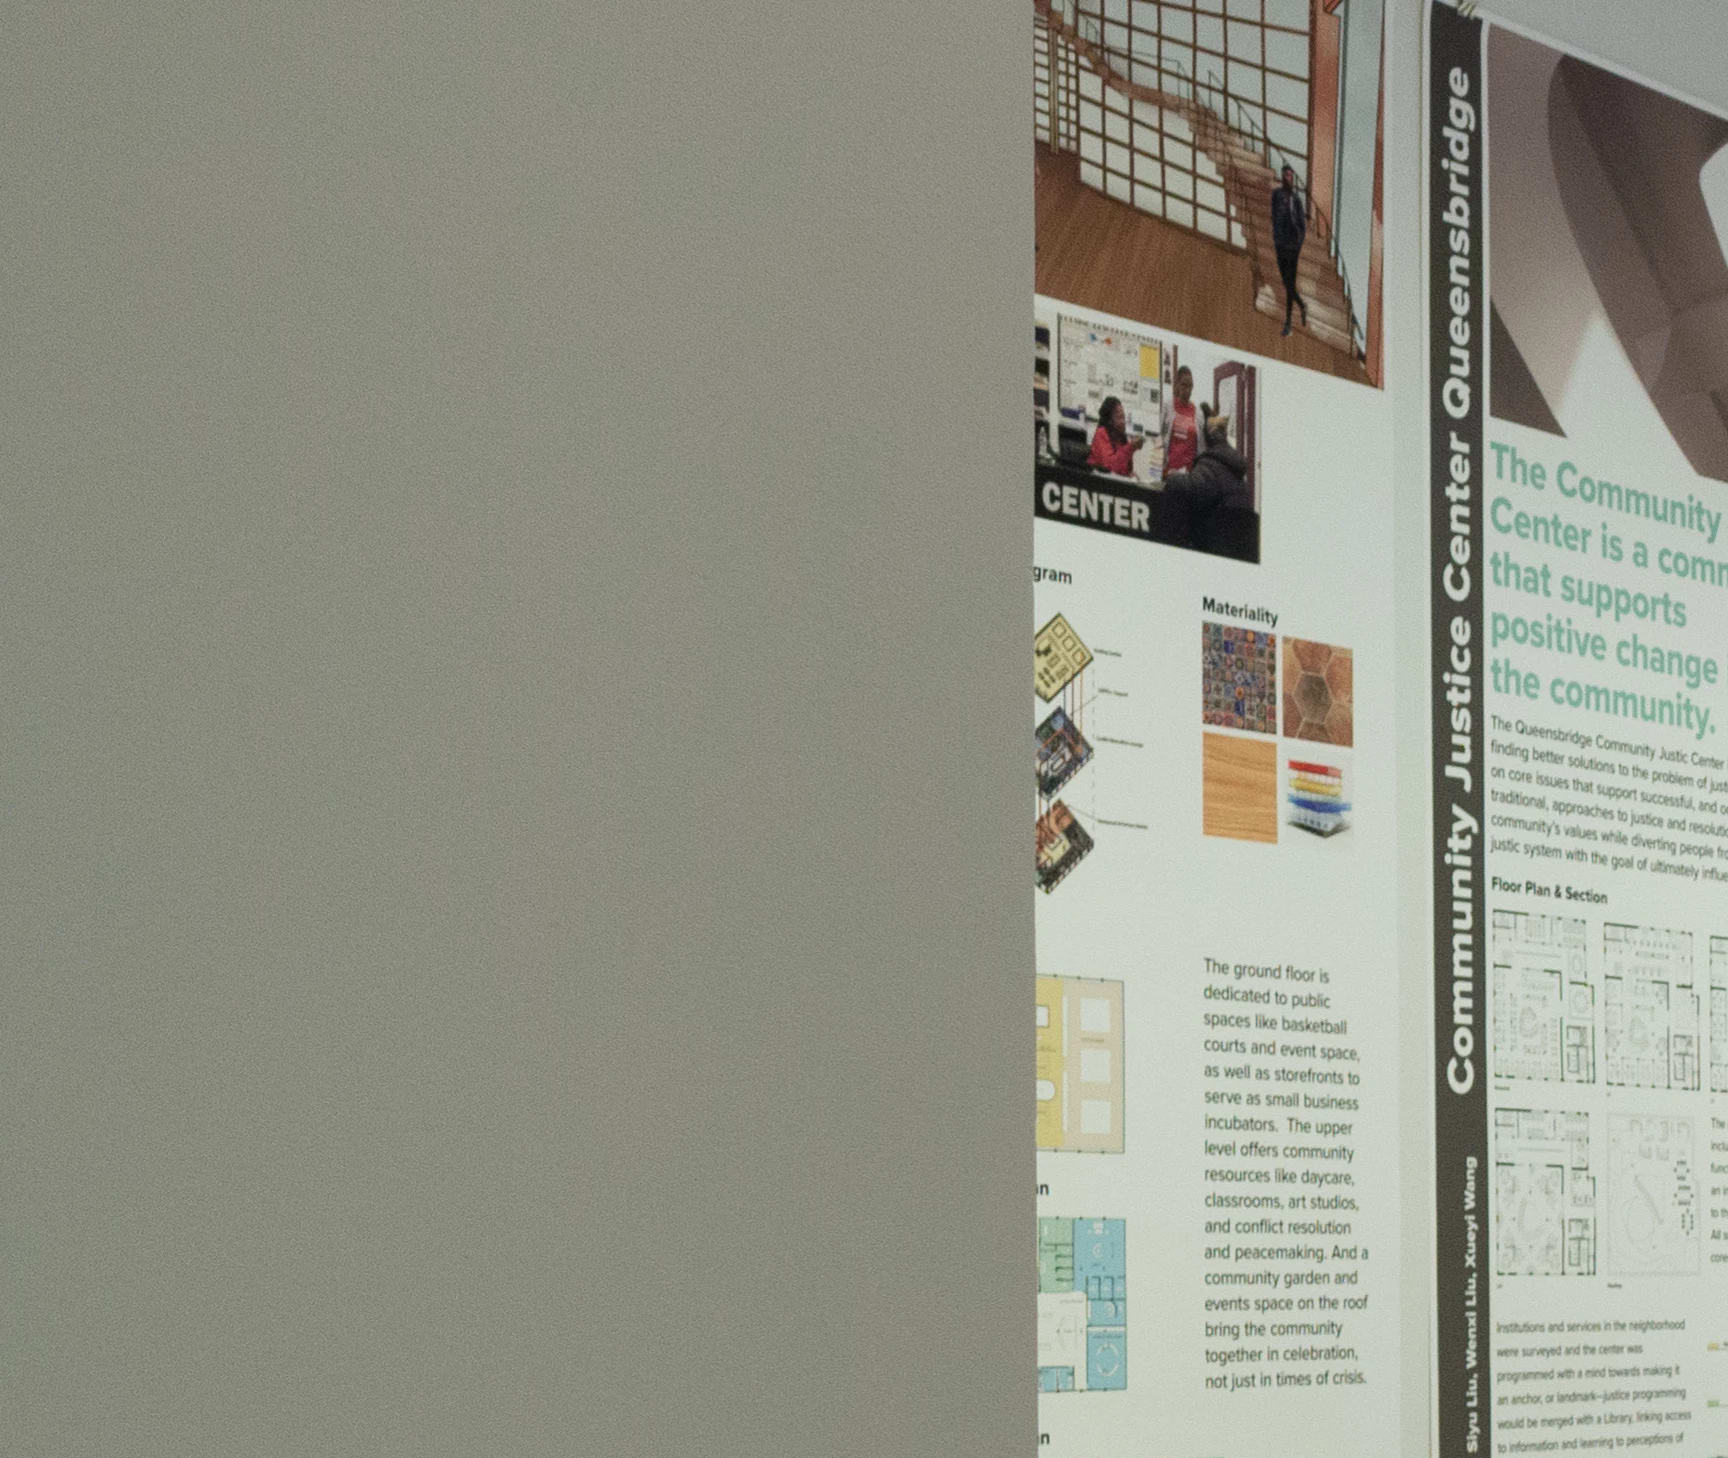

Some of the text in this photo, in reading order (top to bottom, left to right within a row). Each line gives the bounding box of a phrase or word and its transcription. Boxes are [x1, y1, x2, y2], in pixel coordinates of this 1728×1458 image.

[1490, 441, 1546, 490] The
[1557, 461, 1721, 544] Community
[1042, 481, 1150, 533] CENTER
[1491, 496, 1592, 553] Center
[1602, 522, 1623, 562] is
[1633, 541, 1648, 568] a
[1442, 67, 1479, 1094] Community Justice Center Queensbridge
[1490, 552, 1686, 627] that supports
[1203, 597, 1279, 628] Materiality
[1492, 612, 1606, 661] positive
[1617, 634, 1718, 689] change
[1491, 658, 1715, 740] the community.
[1490, 713, 1513, 733] The
[1514, 718, 1593, 750] Queensbridge
[1595, 733, 1656, 762] Community
[1690, 751, 1725, 771] Center
[1490, 738, 1530, 764] finding
[1532, 746, 1565, 765] better
[1567, 755, 1616, 775] solutions
[1617, 762, 1630, 777] to
[1631, 764, 1649, 781] the
[1651, 770, 1694, 787] problem
[1696, 775, 1708, 790] of
[1491, 875, 1608, 904] Floor Plan & Section
[1203, 956, 1330, 985] The ground floor is
[1203, 984, 1331, 1010] dedicated to public
[1203, 1012, 1348, 1035] spaces like basketball
[1203, 1038, 1247, 1054] courts
[1250, 1040, 1277, 1056] and
[1279, 1044, 1317, 1059] event
[1203, 1064, 1361, 1086] as well as storefronts to
[1204, 1091, 1360, 1112] serve as small business
[1286, 1116, 1312, 1134] The
[1315, 1122, 1353, 1138] upper
[1204, 1139, 1355, 1164] level offers community
[1204, 1168, 1271, 1184] resources
[1274, 1167, 1298, 1184] like
[1463, 1155, 1479, 1211] Wang
[1287, 1195, 1307, 1210] art
[1204, 1218, 1352, 1236] and conflict resolution
[1204, 1243, 1231, 1260] and
[1331, 1244, 1358, 1261] And
[1361, 1248, 1369, 1261] a
[1463, 1214, 1479, 1269] Xueyi
[1204, 1269, 1358, 1290] community garden and
[1204, 1294, 1369, 1315] events space on the roof
[1204, 1319, 1344, 1342] bring the community
[1464, 1310, 1478, 1370] Wenxi
[1204, 1347, 1263, 1367] together
[1267, 1346, 1280, 1361] in
[1205, 1374, 1228, 1389] not
[1230, 1373, 1256, 1393] just
[1259, 1372, 1272, 1387] in
[1275, 1372, 1313, 1387] times
[1315, 1369, 1330, 1386] of
[1466, 1411, 1481, 1453] Siyu
